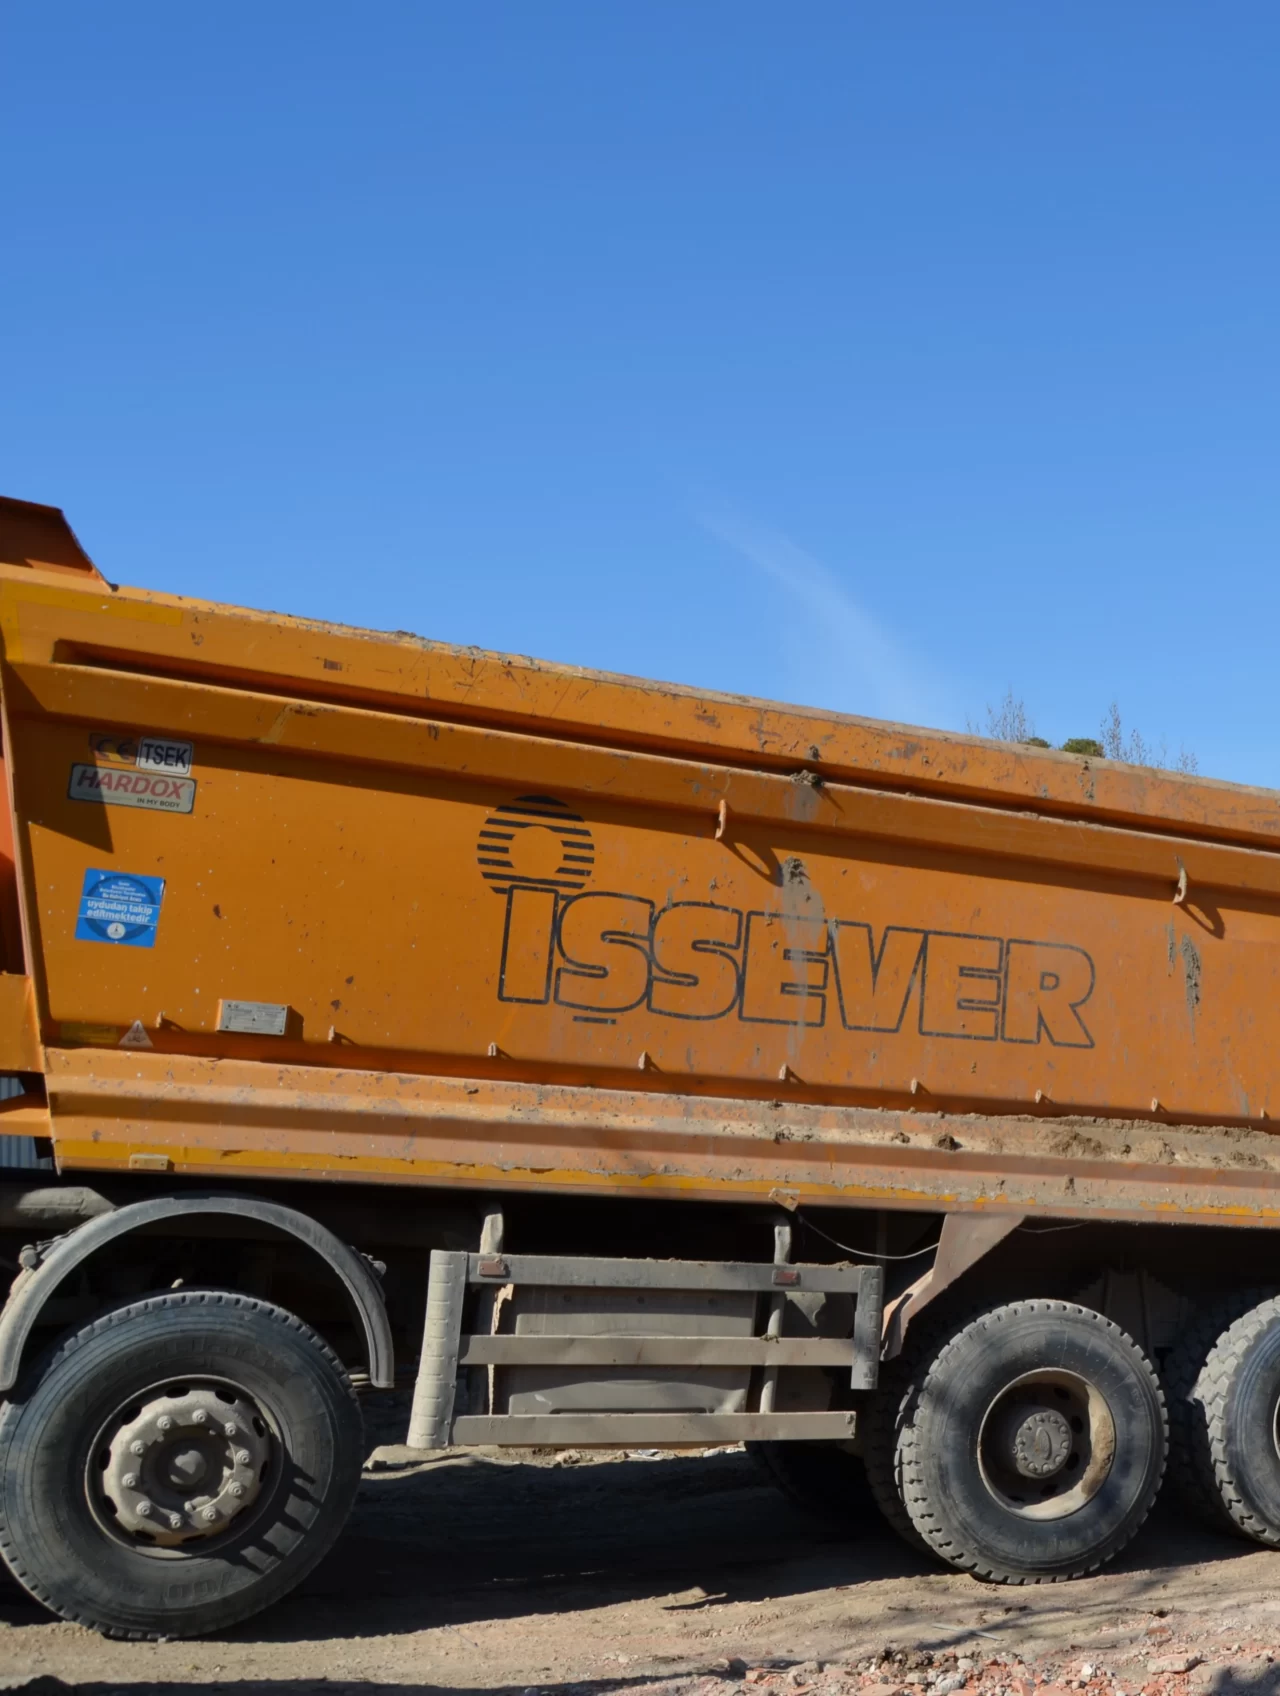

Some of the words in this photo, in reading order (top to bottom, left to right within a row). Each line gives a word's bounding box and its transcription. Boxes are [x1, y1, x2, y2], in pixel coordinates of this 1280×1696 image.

[143, 742, 189, 769] TSEK
[77, 768, 187, 801] HARDOX
[160, 800, 180, 808] BODY
